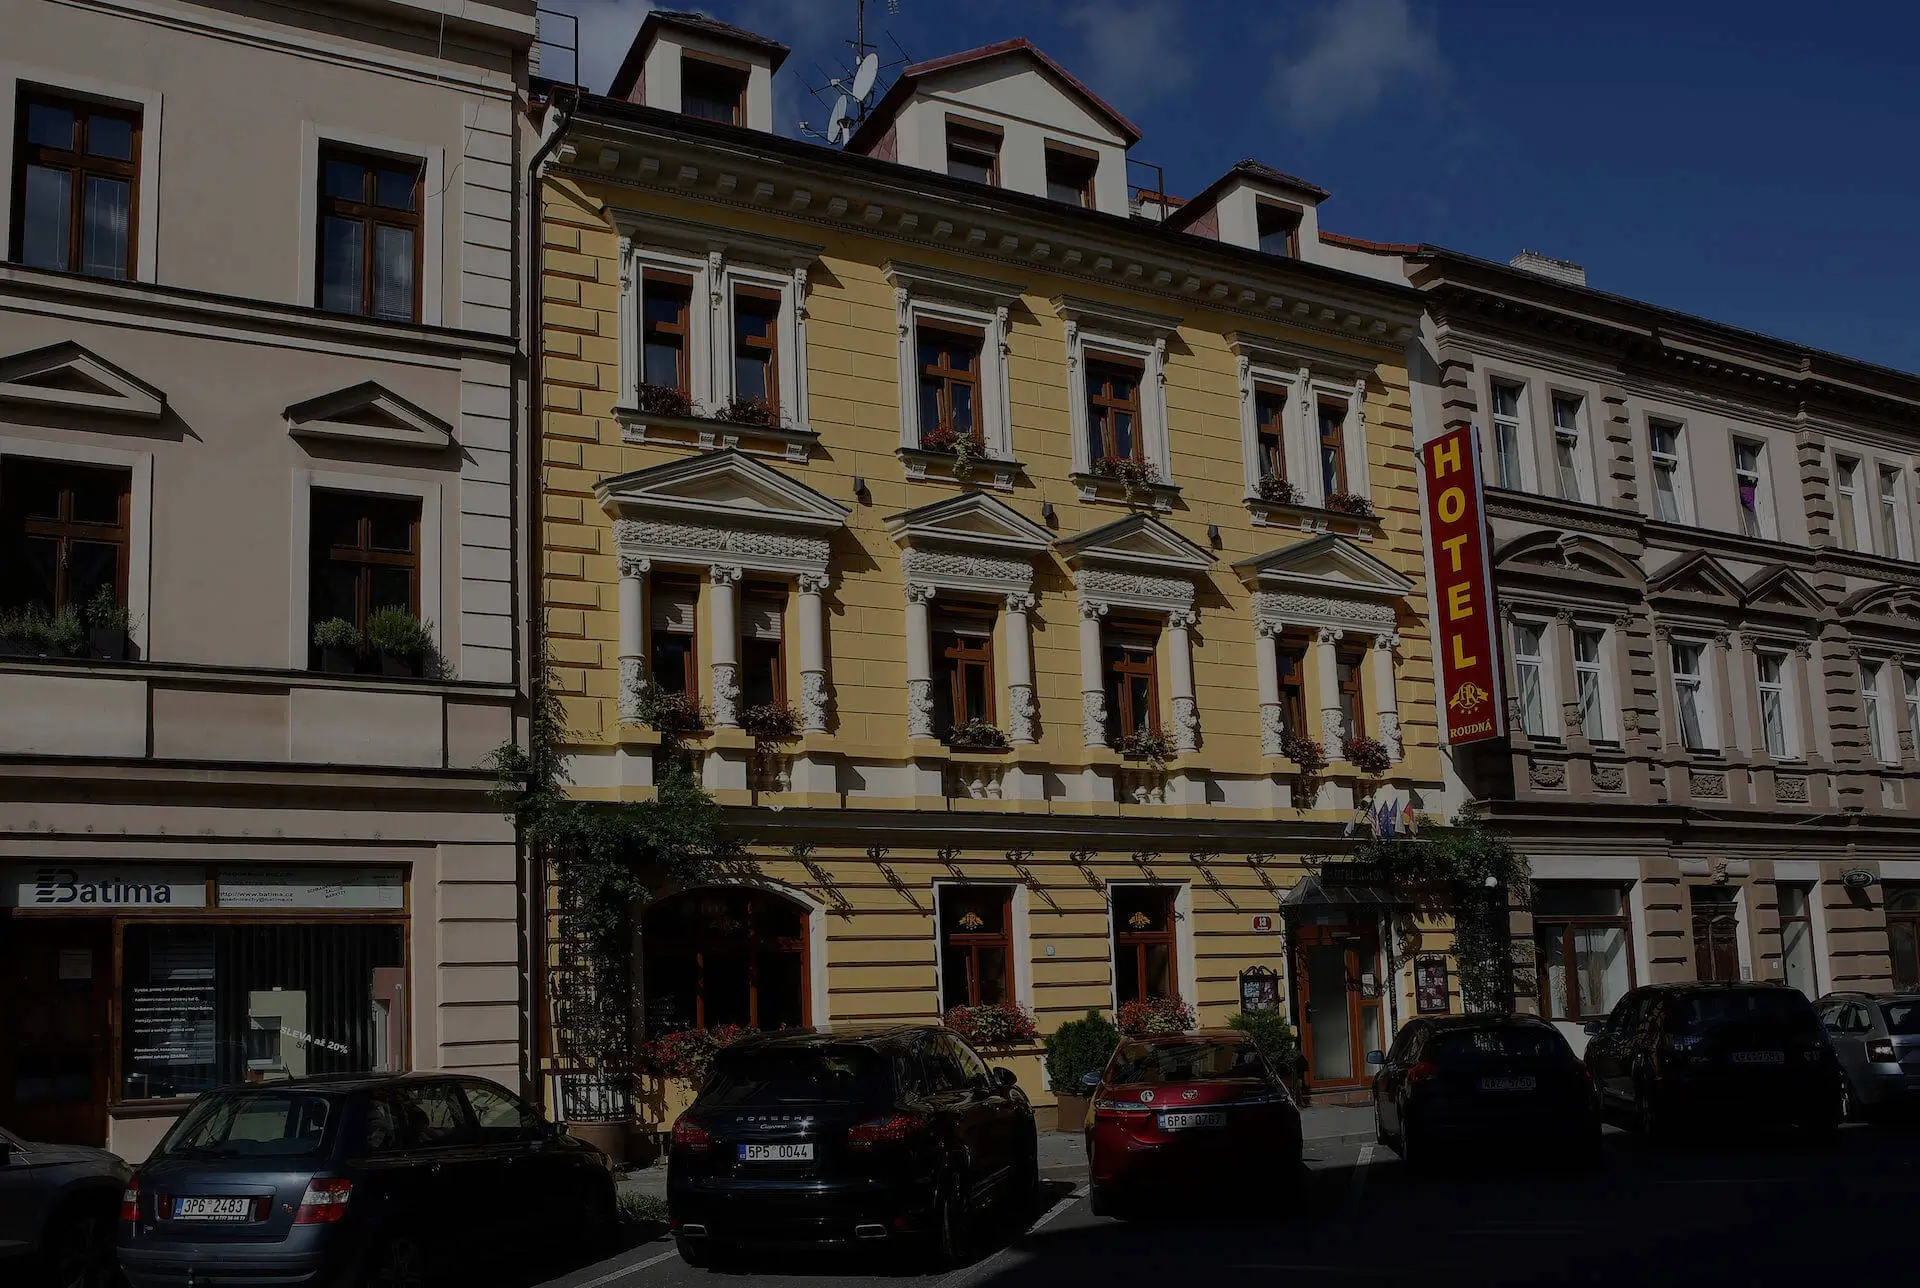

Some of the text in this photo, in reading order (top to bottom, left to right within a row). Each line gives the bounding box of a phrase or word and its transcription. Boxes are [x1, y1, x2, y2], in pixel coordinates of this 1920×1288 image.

[1432, 435, 1477, 671] HOTEL
[1450, 718, 1493, 739] ROUDNÁ
[35, 868, 171, 904] Batima
[280, 1026, 349, 1055] SLEVA až 20%
[1167, 1115, 1187, 1127] 6P8
[748, 1145, 808, 1158] 5P5 0044
[184, 1199, 243, 1213] 3P6 2483
